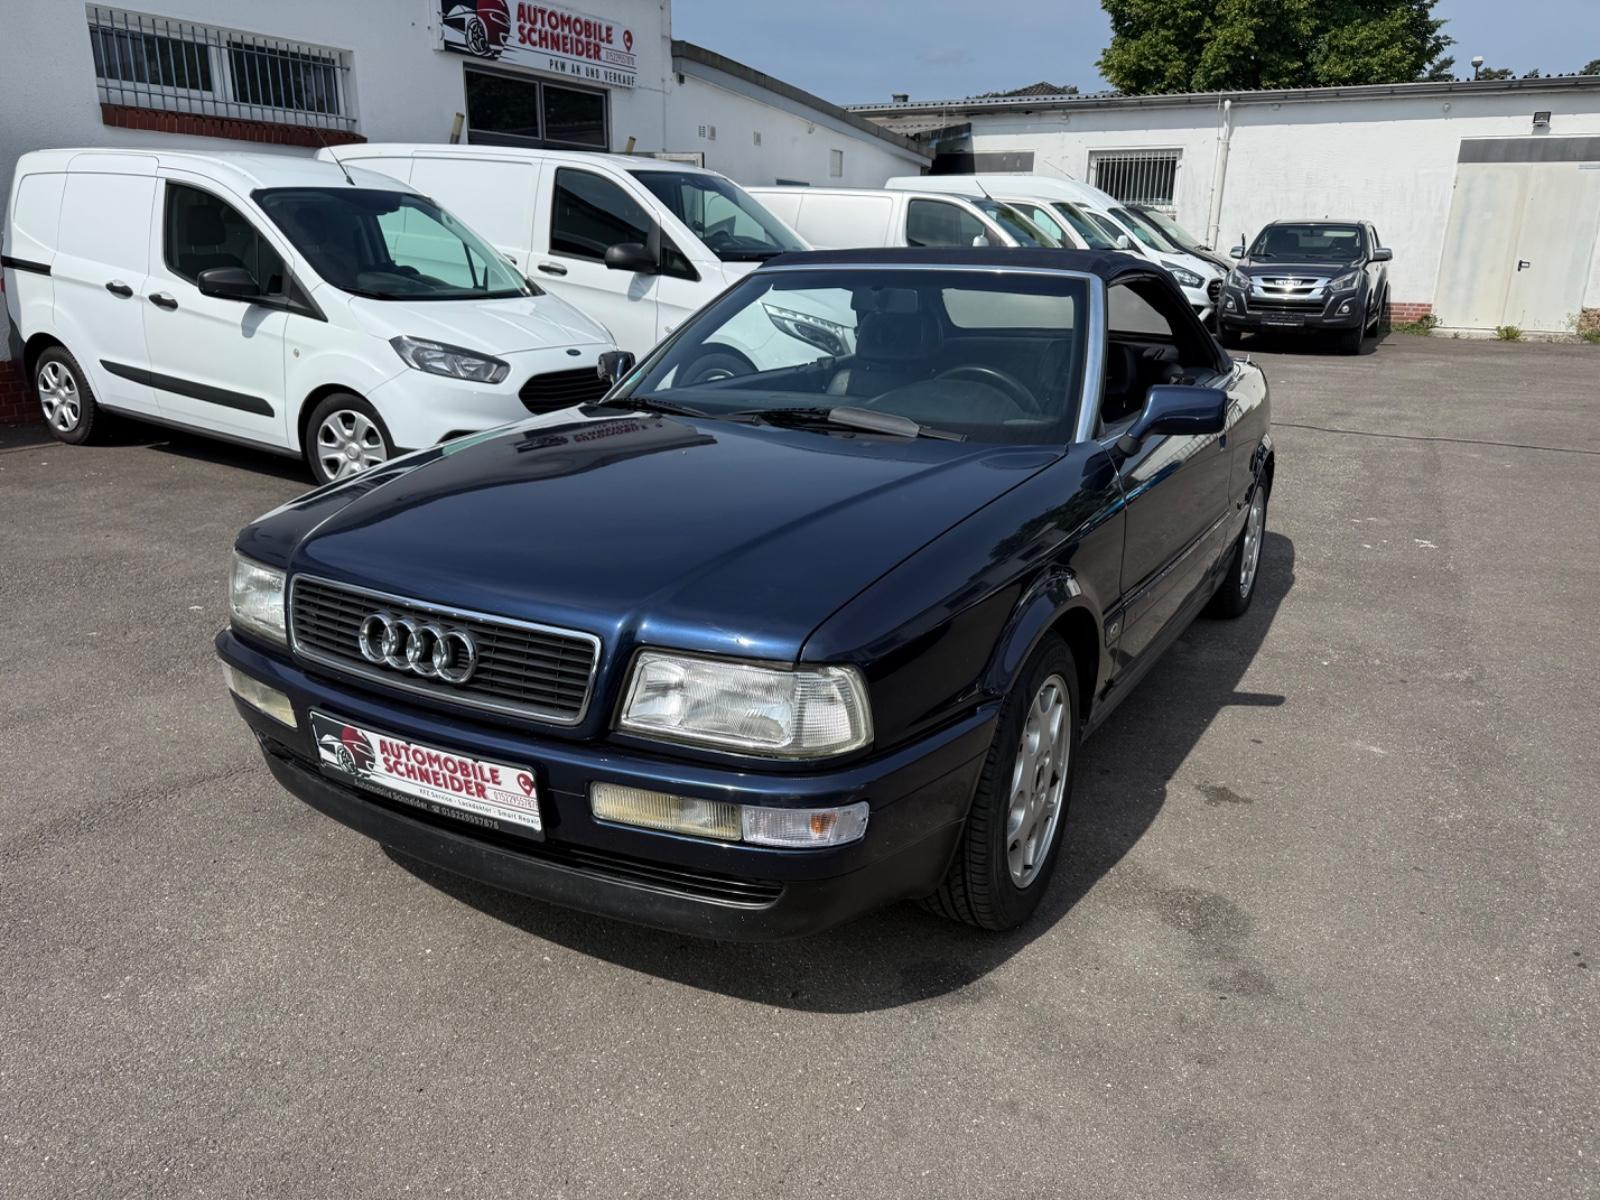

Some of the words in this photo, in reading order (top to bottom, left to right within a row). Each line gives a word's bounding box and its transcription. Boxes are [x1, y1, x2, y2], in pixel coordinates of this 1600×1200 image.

[517, 2, 613, 45] AUTOMOBILE
[518, 24, 602, 60] SCHNEIDER
[549, 58, 566, 72] PKW
[571, 63, 581, 75] AN
[585, 66, 600, 79] UND
[604, 70, 636, 86] VERKAUF
[379, 739, 502, 786] AUTOMOBILE
[383, 757, 489, 800] SCHNEIDER
